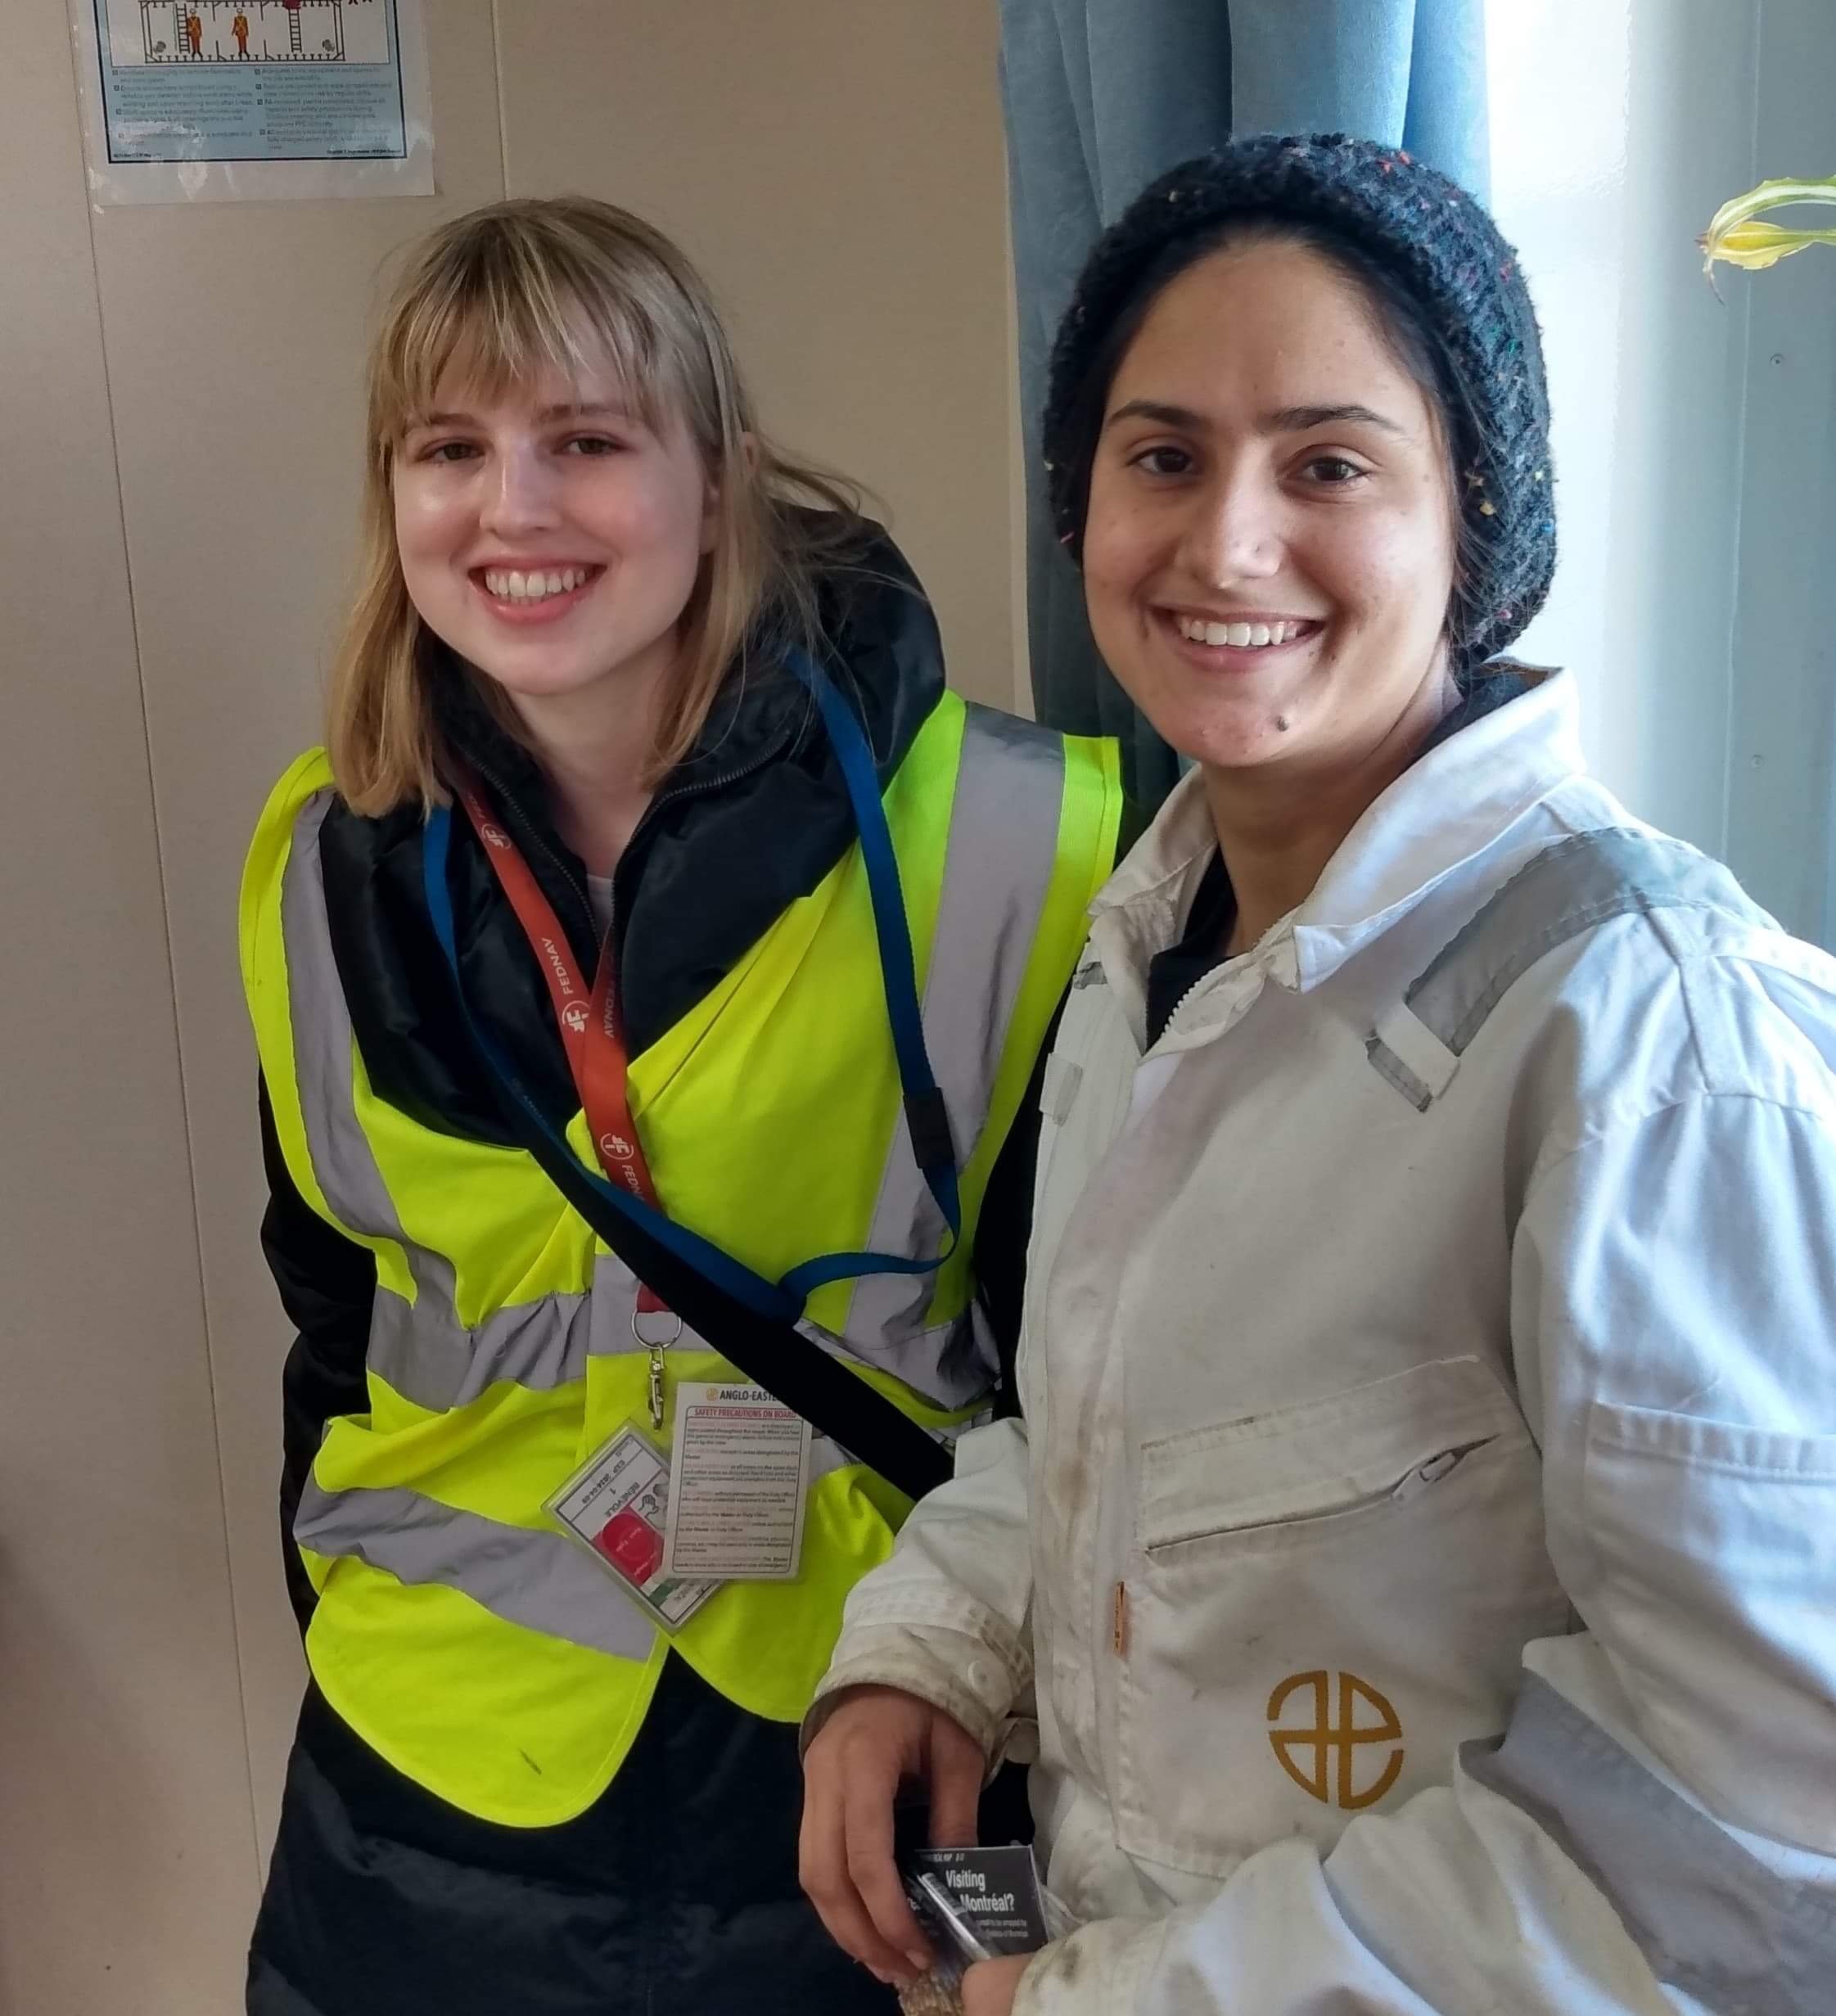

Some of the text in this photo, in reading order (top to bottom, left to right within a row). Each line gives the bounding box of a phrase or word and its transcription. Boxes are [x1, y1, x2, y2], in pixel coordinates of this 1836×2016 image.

[541, 936, 574, 995] FEDNAV
[621, 1164, 645, 1202] FEDN
[719, 1389, 778, 1402] ANGLO-EAST
[694, 1407, 718, 1416] SAFETY
[718, 1408, 762, 1418] PRECAUTIONS
[763, 1409, 774, 1418] ON
[945, 1869, 986, 1892] Visiting
[959, 1892, 1015, 1913] Montréal?
